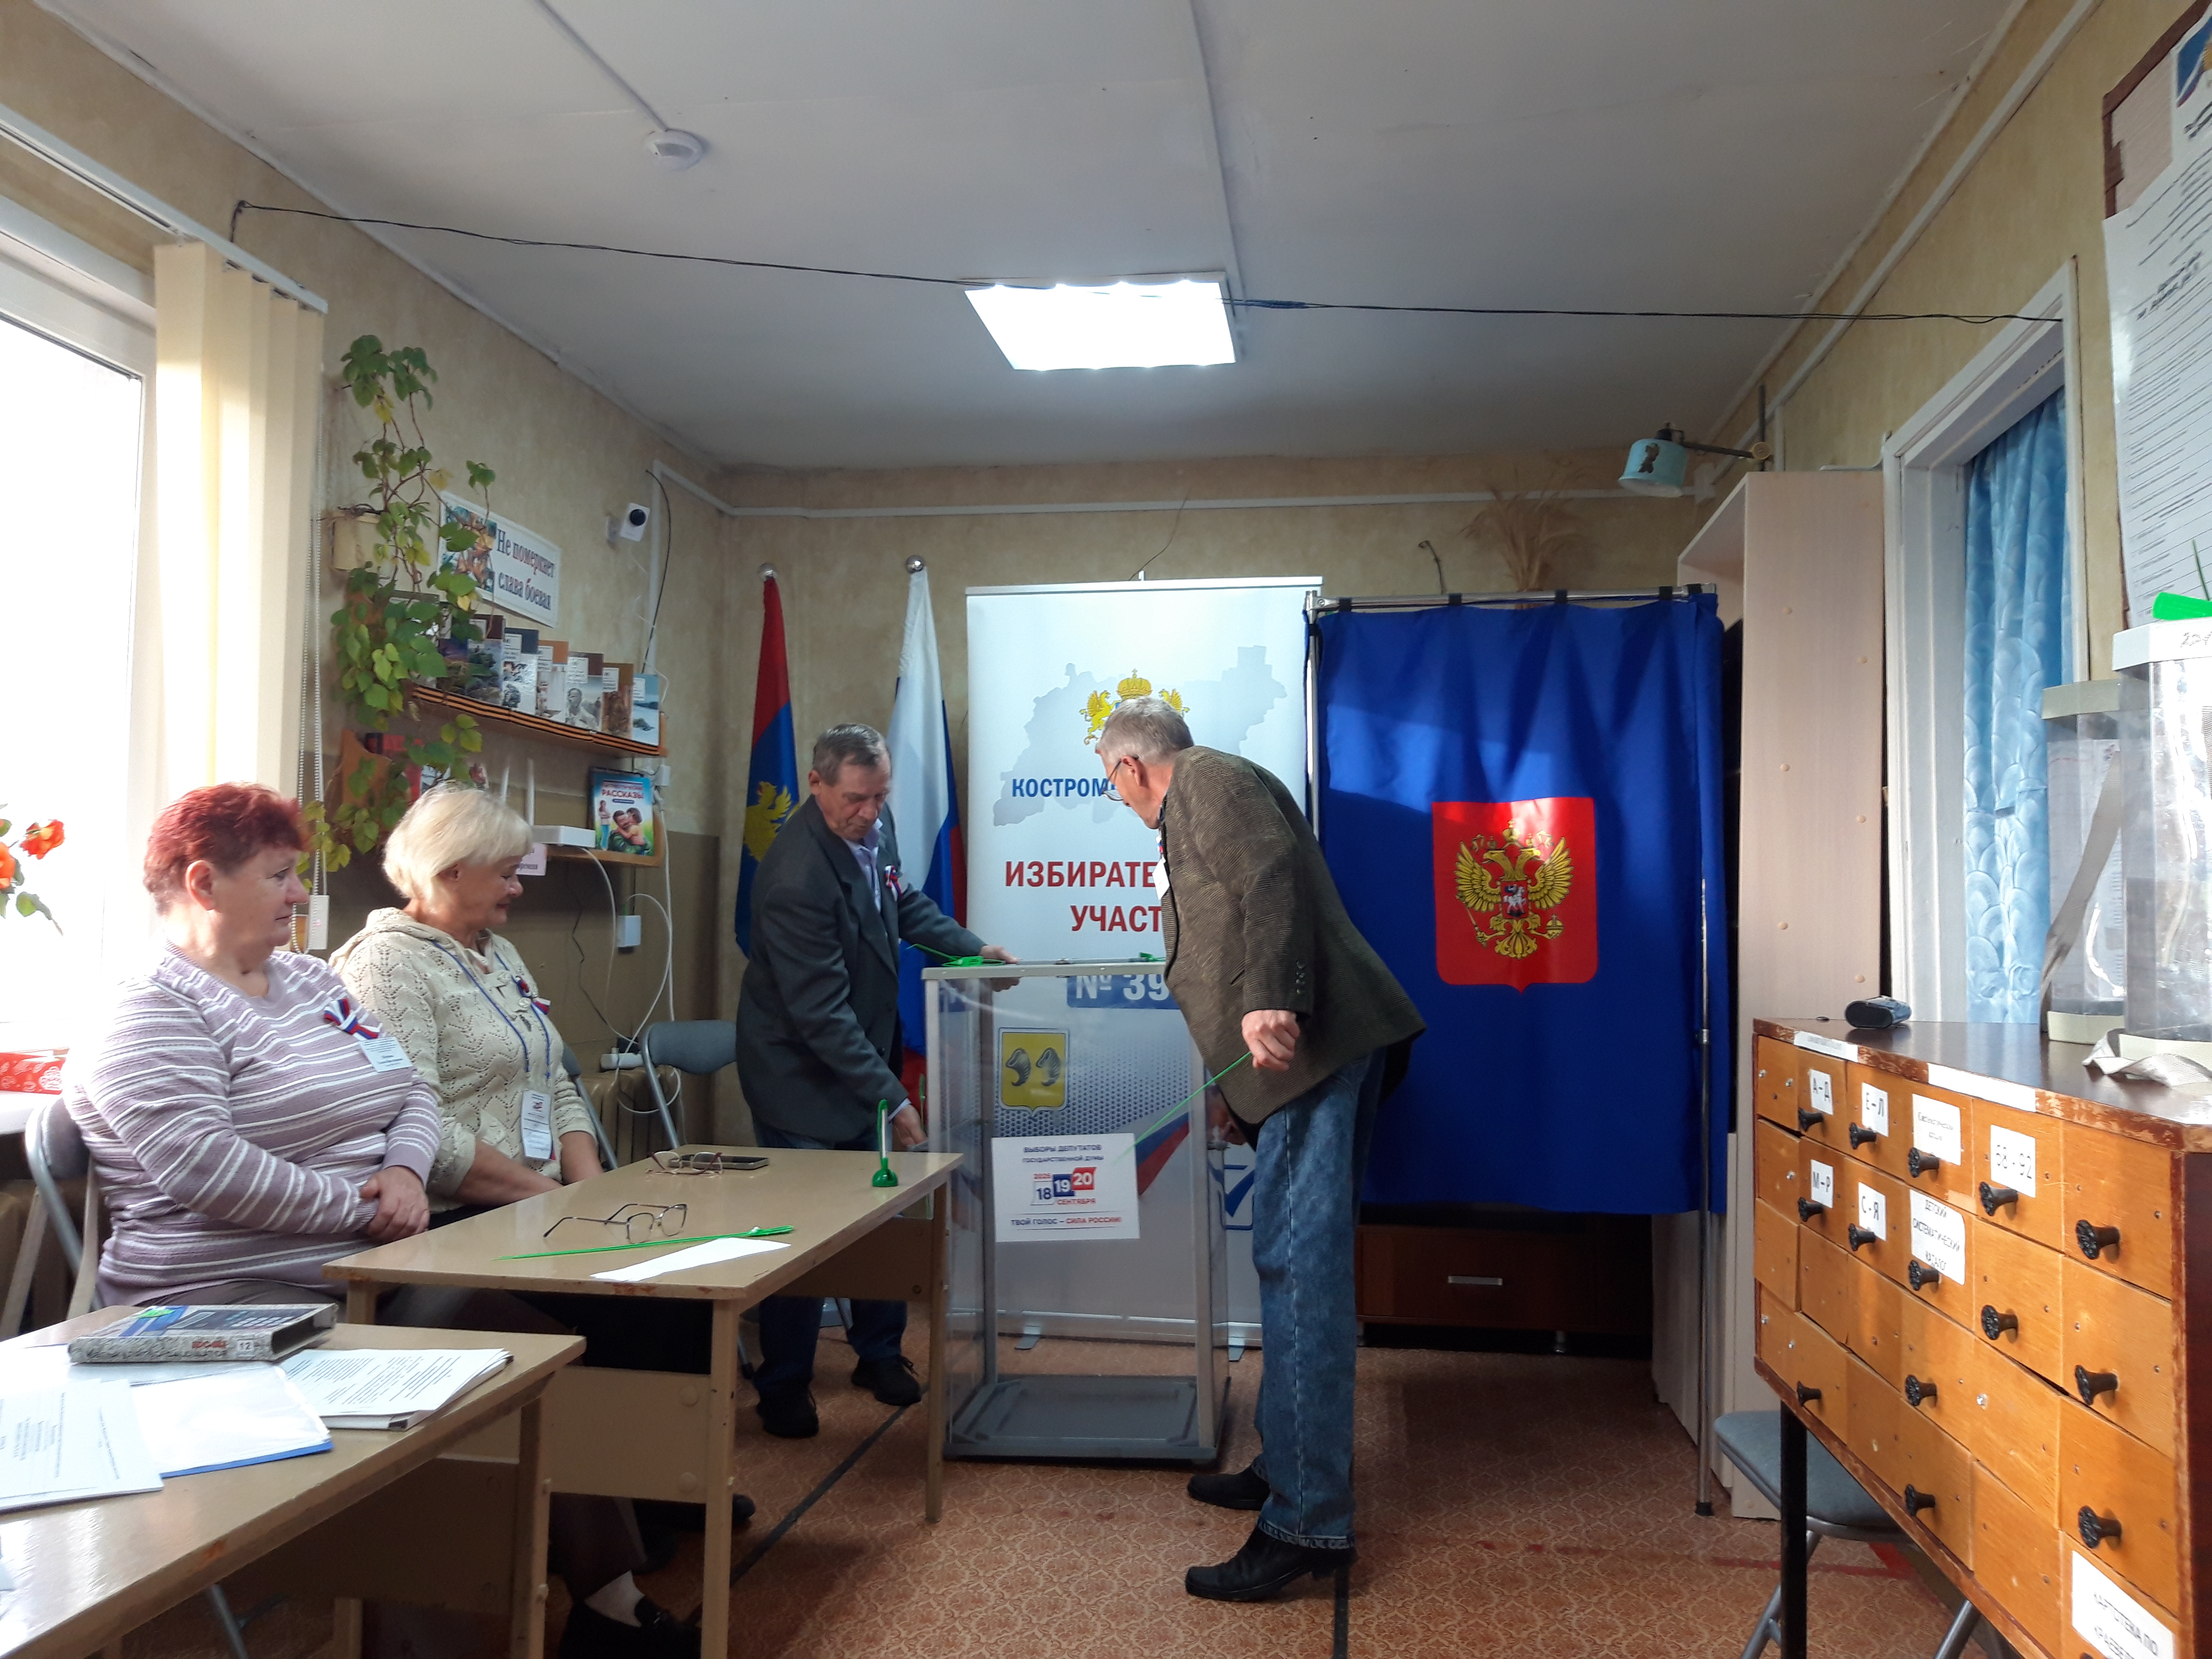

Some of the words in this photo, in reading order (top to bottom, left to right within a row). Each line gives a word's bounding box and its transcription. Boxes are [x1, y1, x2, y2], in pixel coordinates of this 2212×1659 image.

[496, 529, 510, 555] Не
[513, 542, 555, 577] померкнет
[498, 572, 524, 598] слава
[525, 577, 551, 610] боевая
[1012, 778, 1117, 797] КОСТРОМ
[1073, 1172, 1092, 1185] 20
[1054, 1179, 1070, 1192] 19
[1036, 1187, 1052, 1200] 18
[240, 1342, 251, 1350] 12
